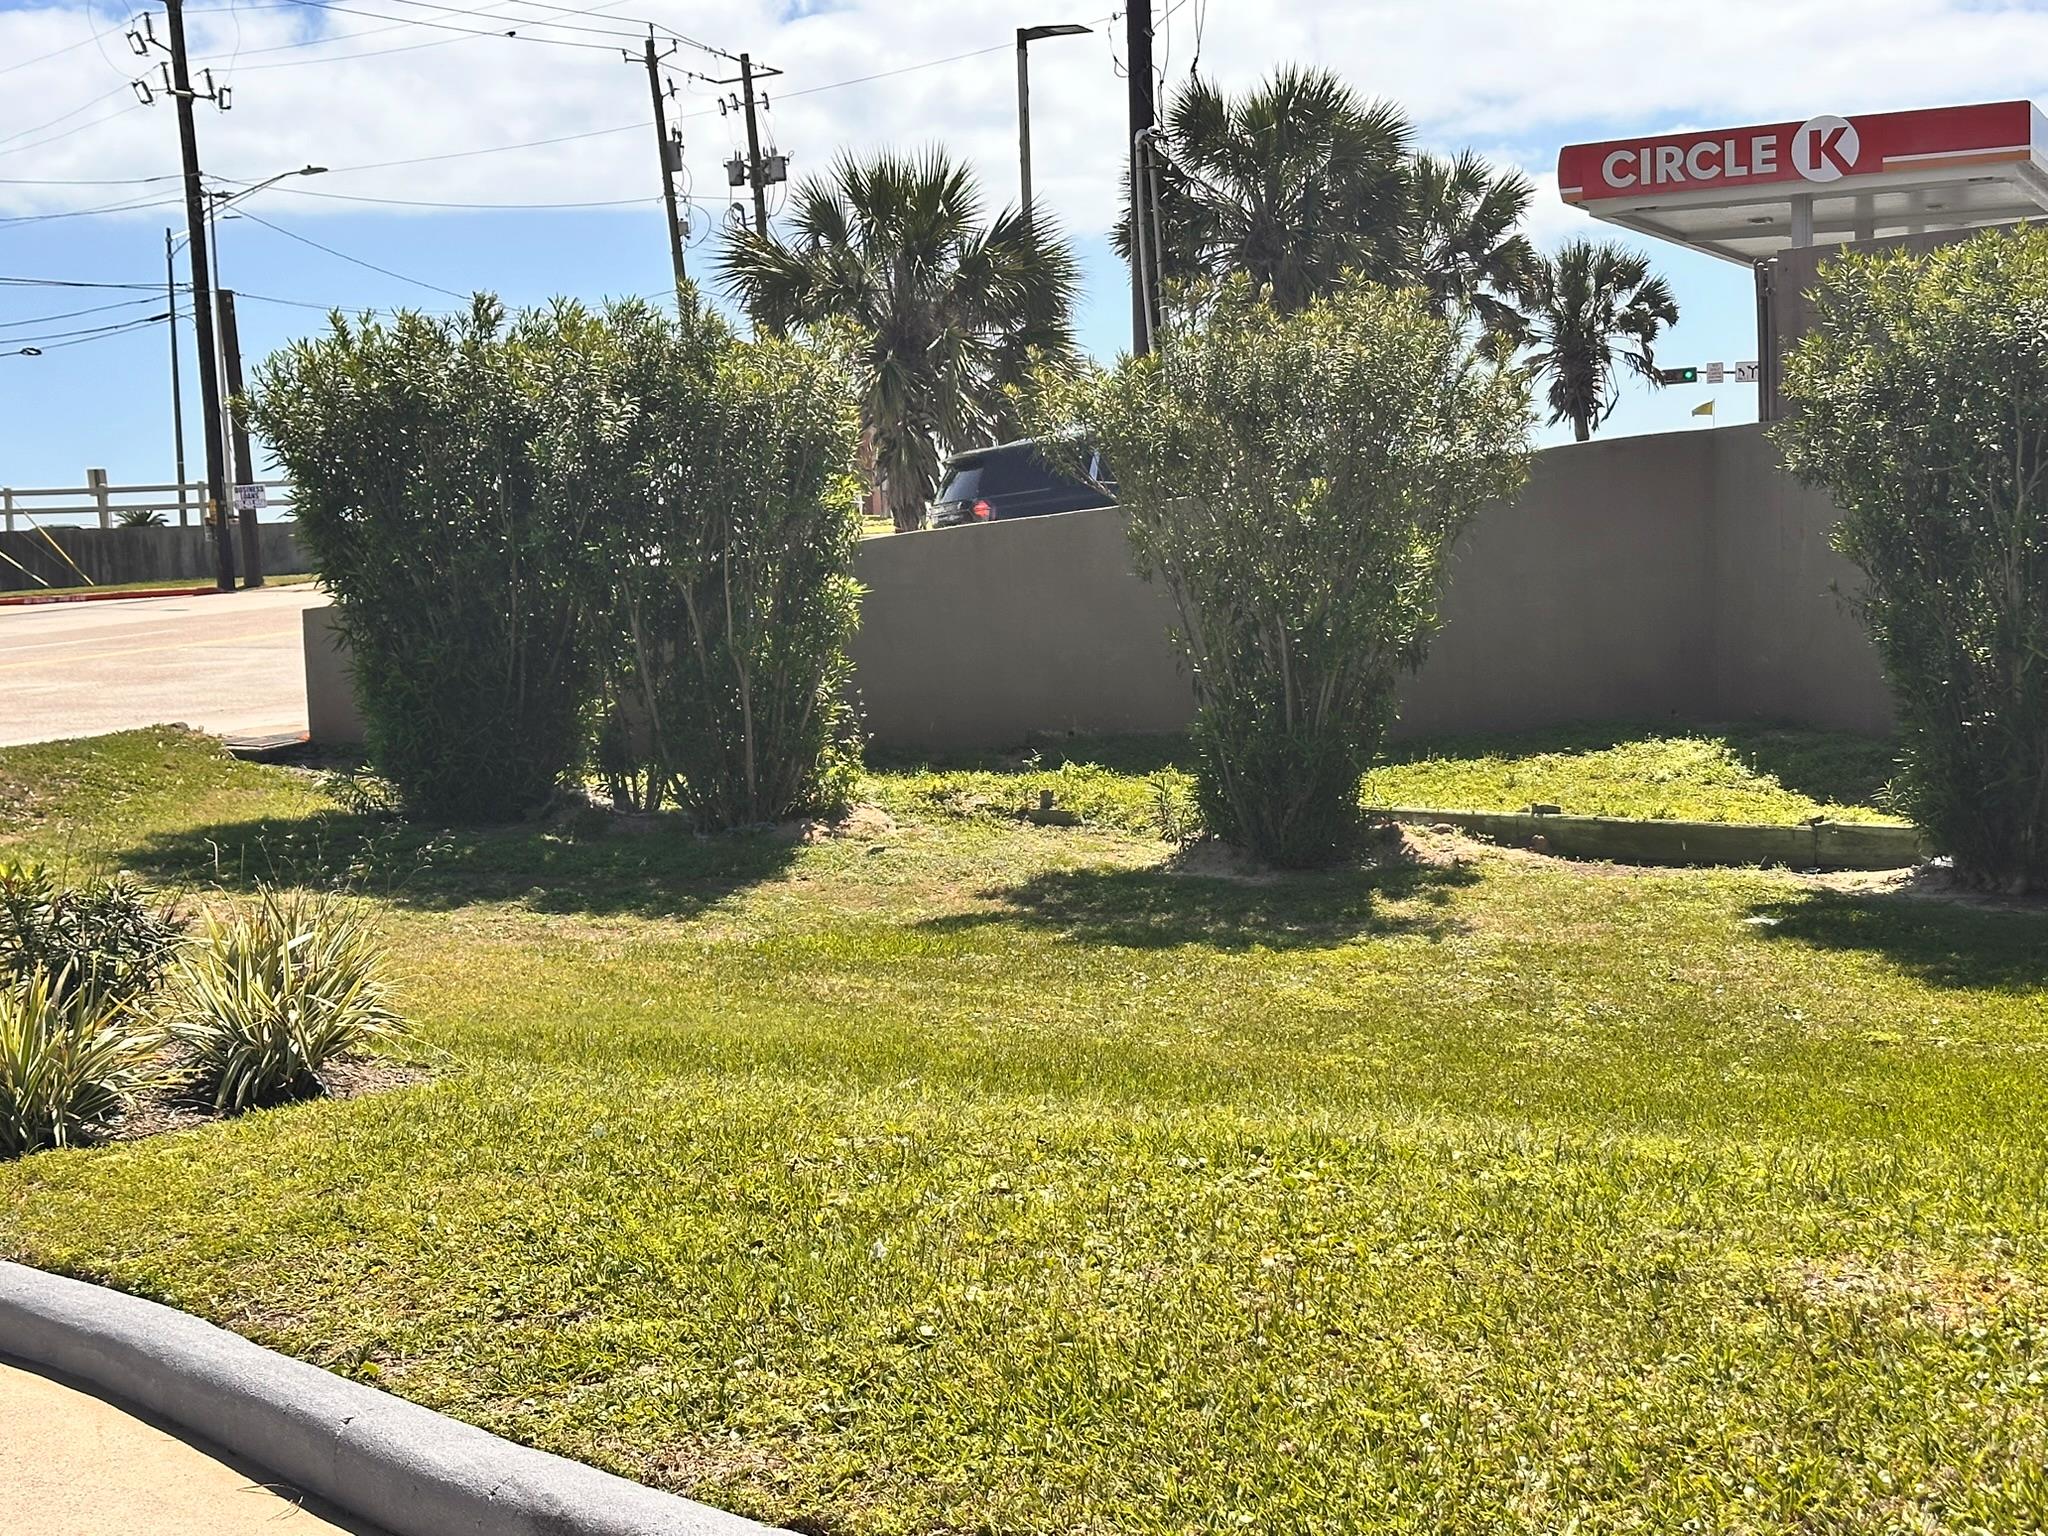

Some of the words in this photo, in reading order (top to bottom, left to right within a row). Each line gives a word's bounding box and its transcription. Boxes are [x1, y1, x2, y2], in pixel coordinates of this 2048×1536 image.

[1601, 135, 1778, 189] CIRCLE
[1803, 120, 1857, 180] K
[234, 485, 264, 494] BUSINESS
